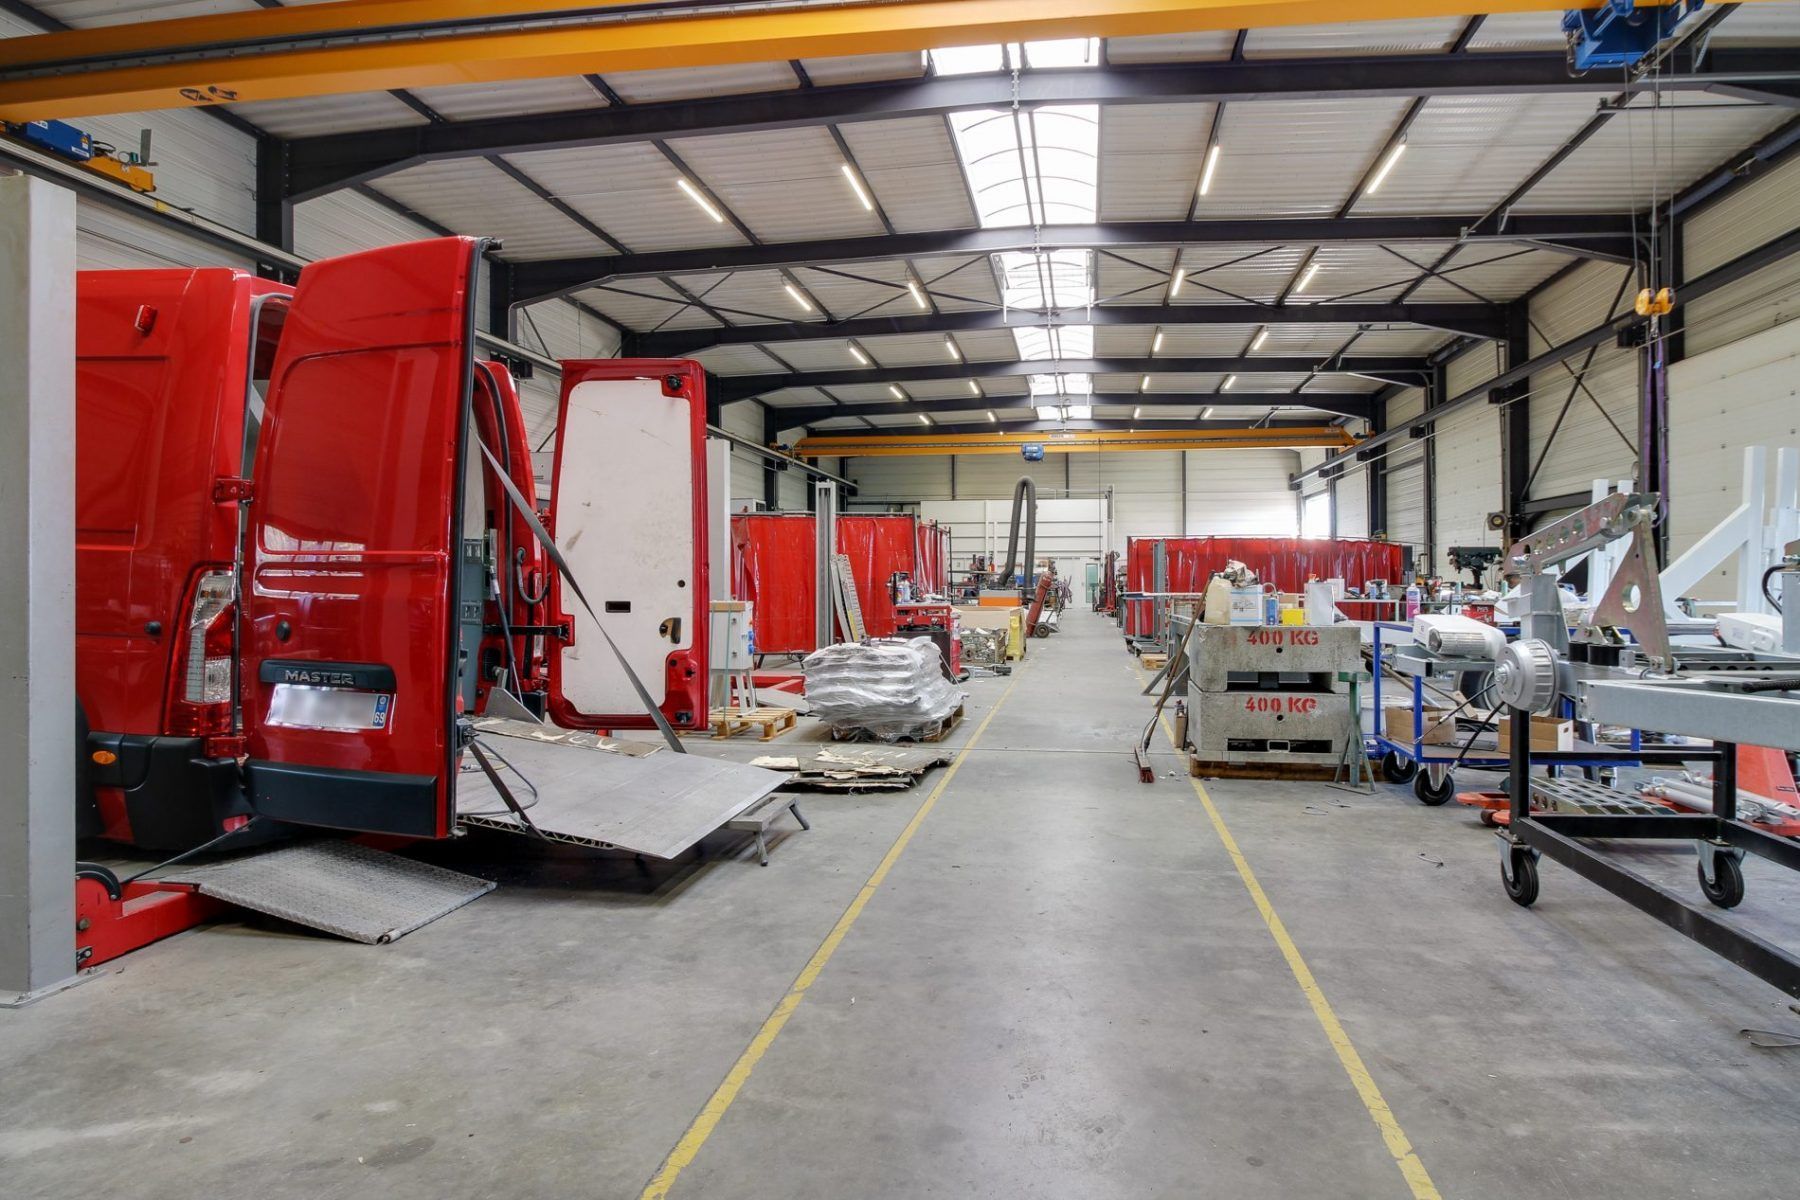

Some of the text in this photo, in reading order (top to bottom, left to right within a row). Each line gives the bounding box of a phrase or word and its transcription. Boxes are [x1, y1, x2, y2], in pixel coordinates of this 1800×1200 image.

[1247, 630, 1319, 646] 400 KG
[285, 670, 354, 685] MASTER
[1245, 696, 1282, 713] 400
[374, 711, 385, 724] 69
